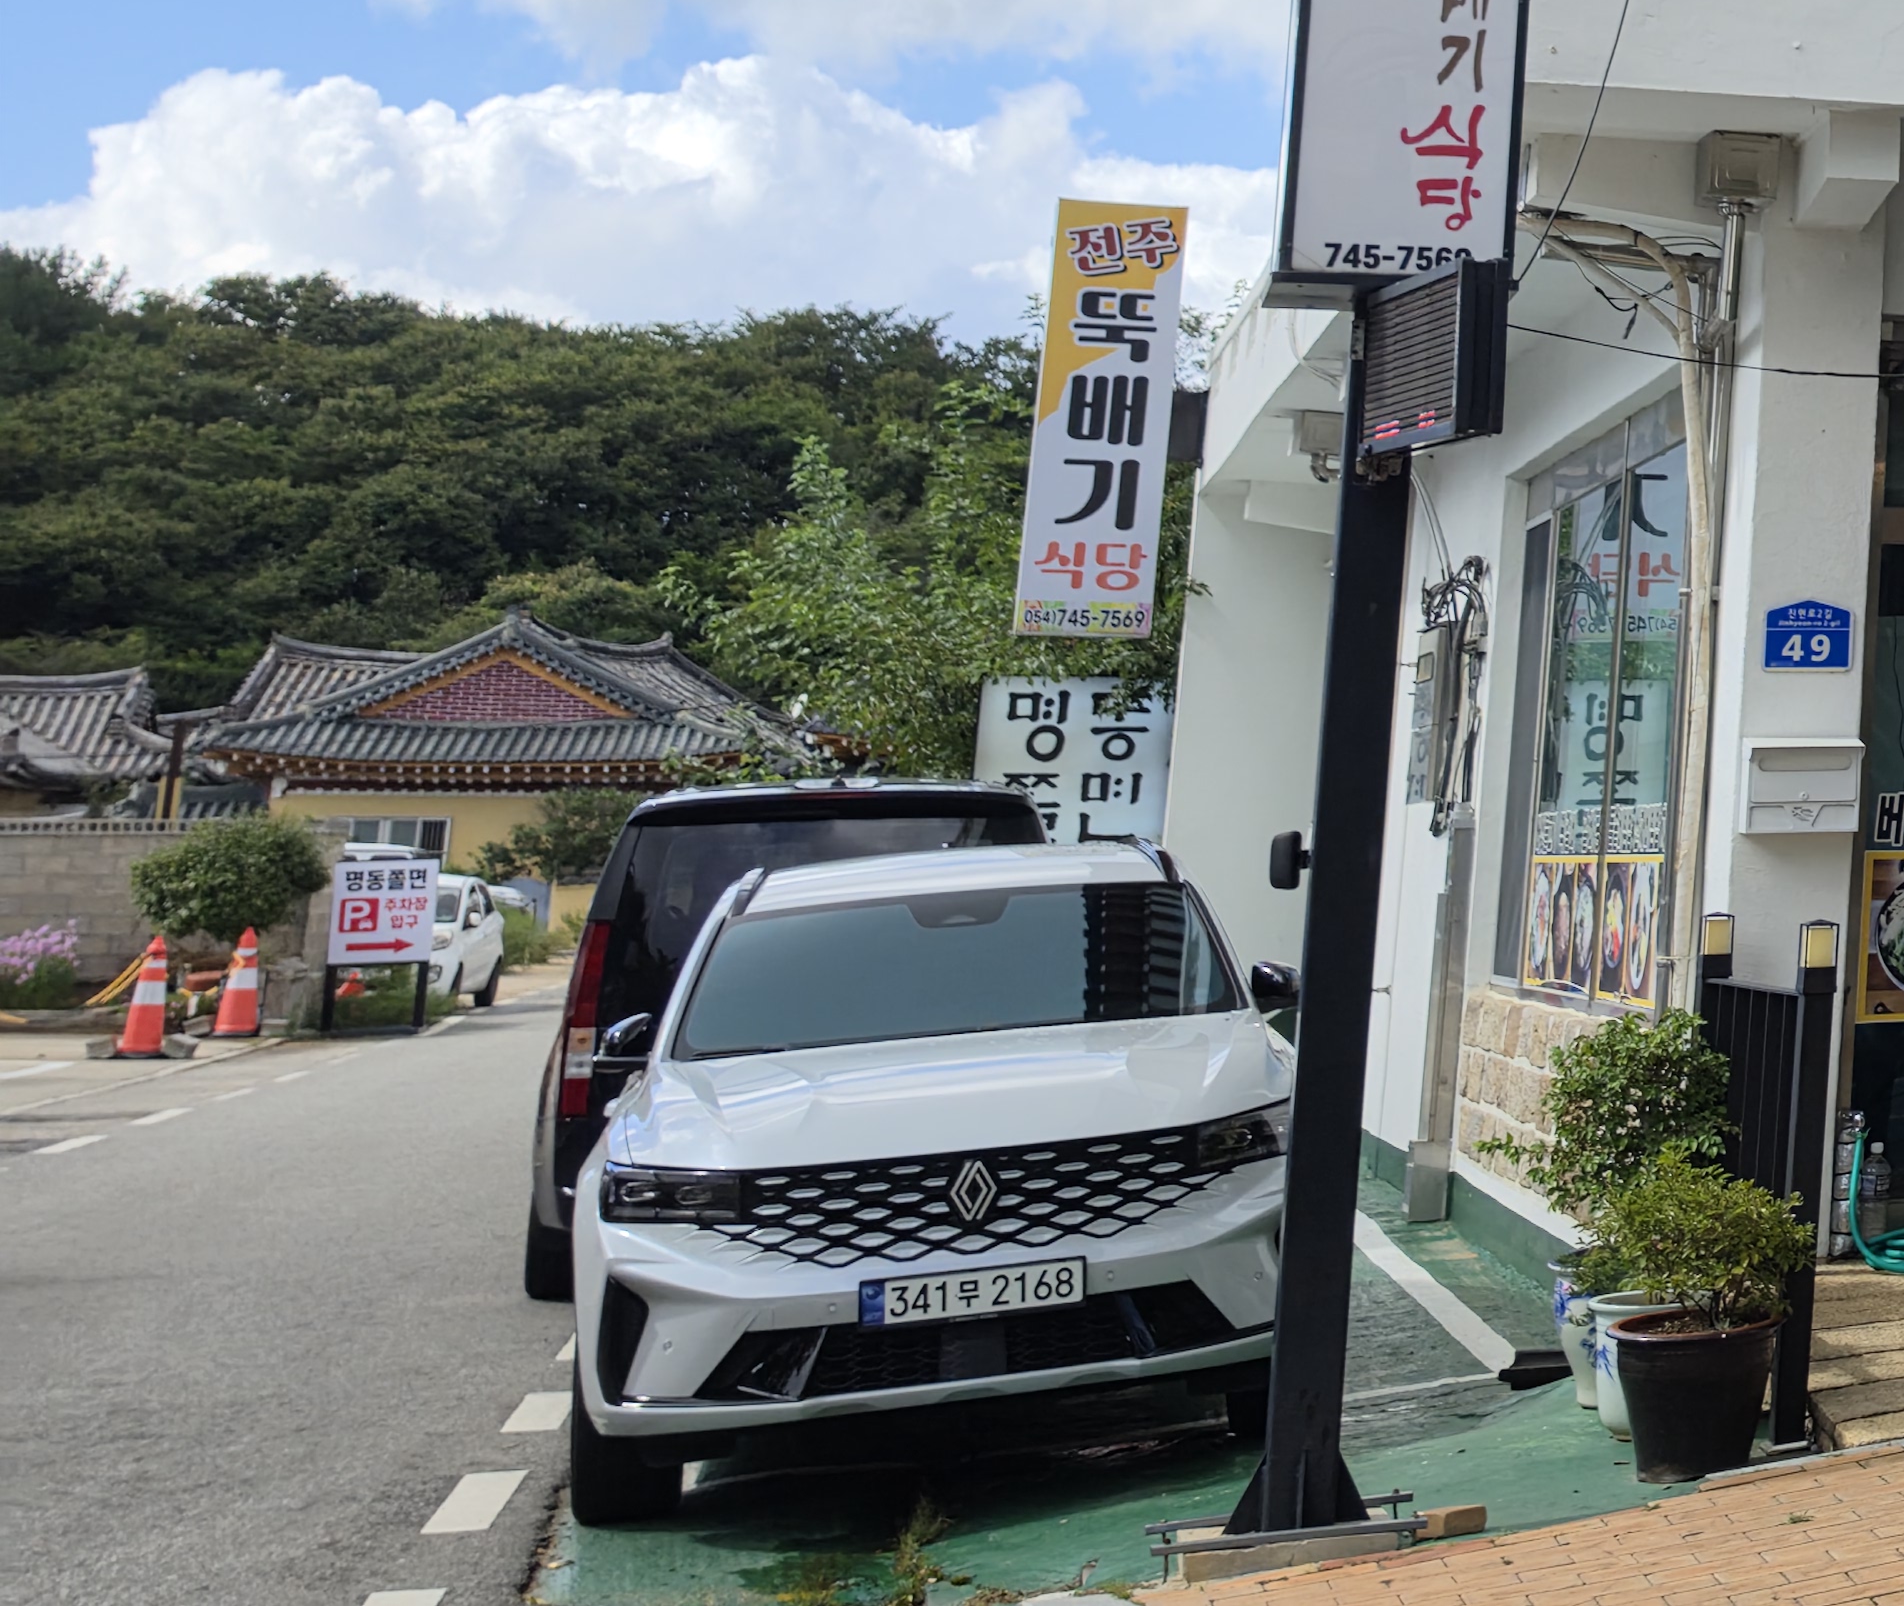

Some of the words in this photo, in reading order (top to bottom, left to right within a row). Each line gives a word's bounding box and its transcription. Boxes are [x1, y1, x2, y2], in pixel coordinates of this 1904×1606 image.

[1400, 104, 1486, 232] 식당
[1067, 216, 1181, 279] 전주
[1053, 290, 1158, 532] 뚝배기
[1034, 540, 1148, 591] 식당
[1781, 634, 1831, 662] 49
[384, 896, 428, 913] 주차장
[390, 914, 419, 929] 입구
[991, 1267, 1075, 1306] 2168
